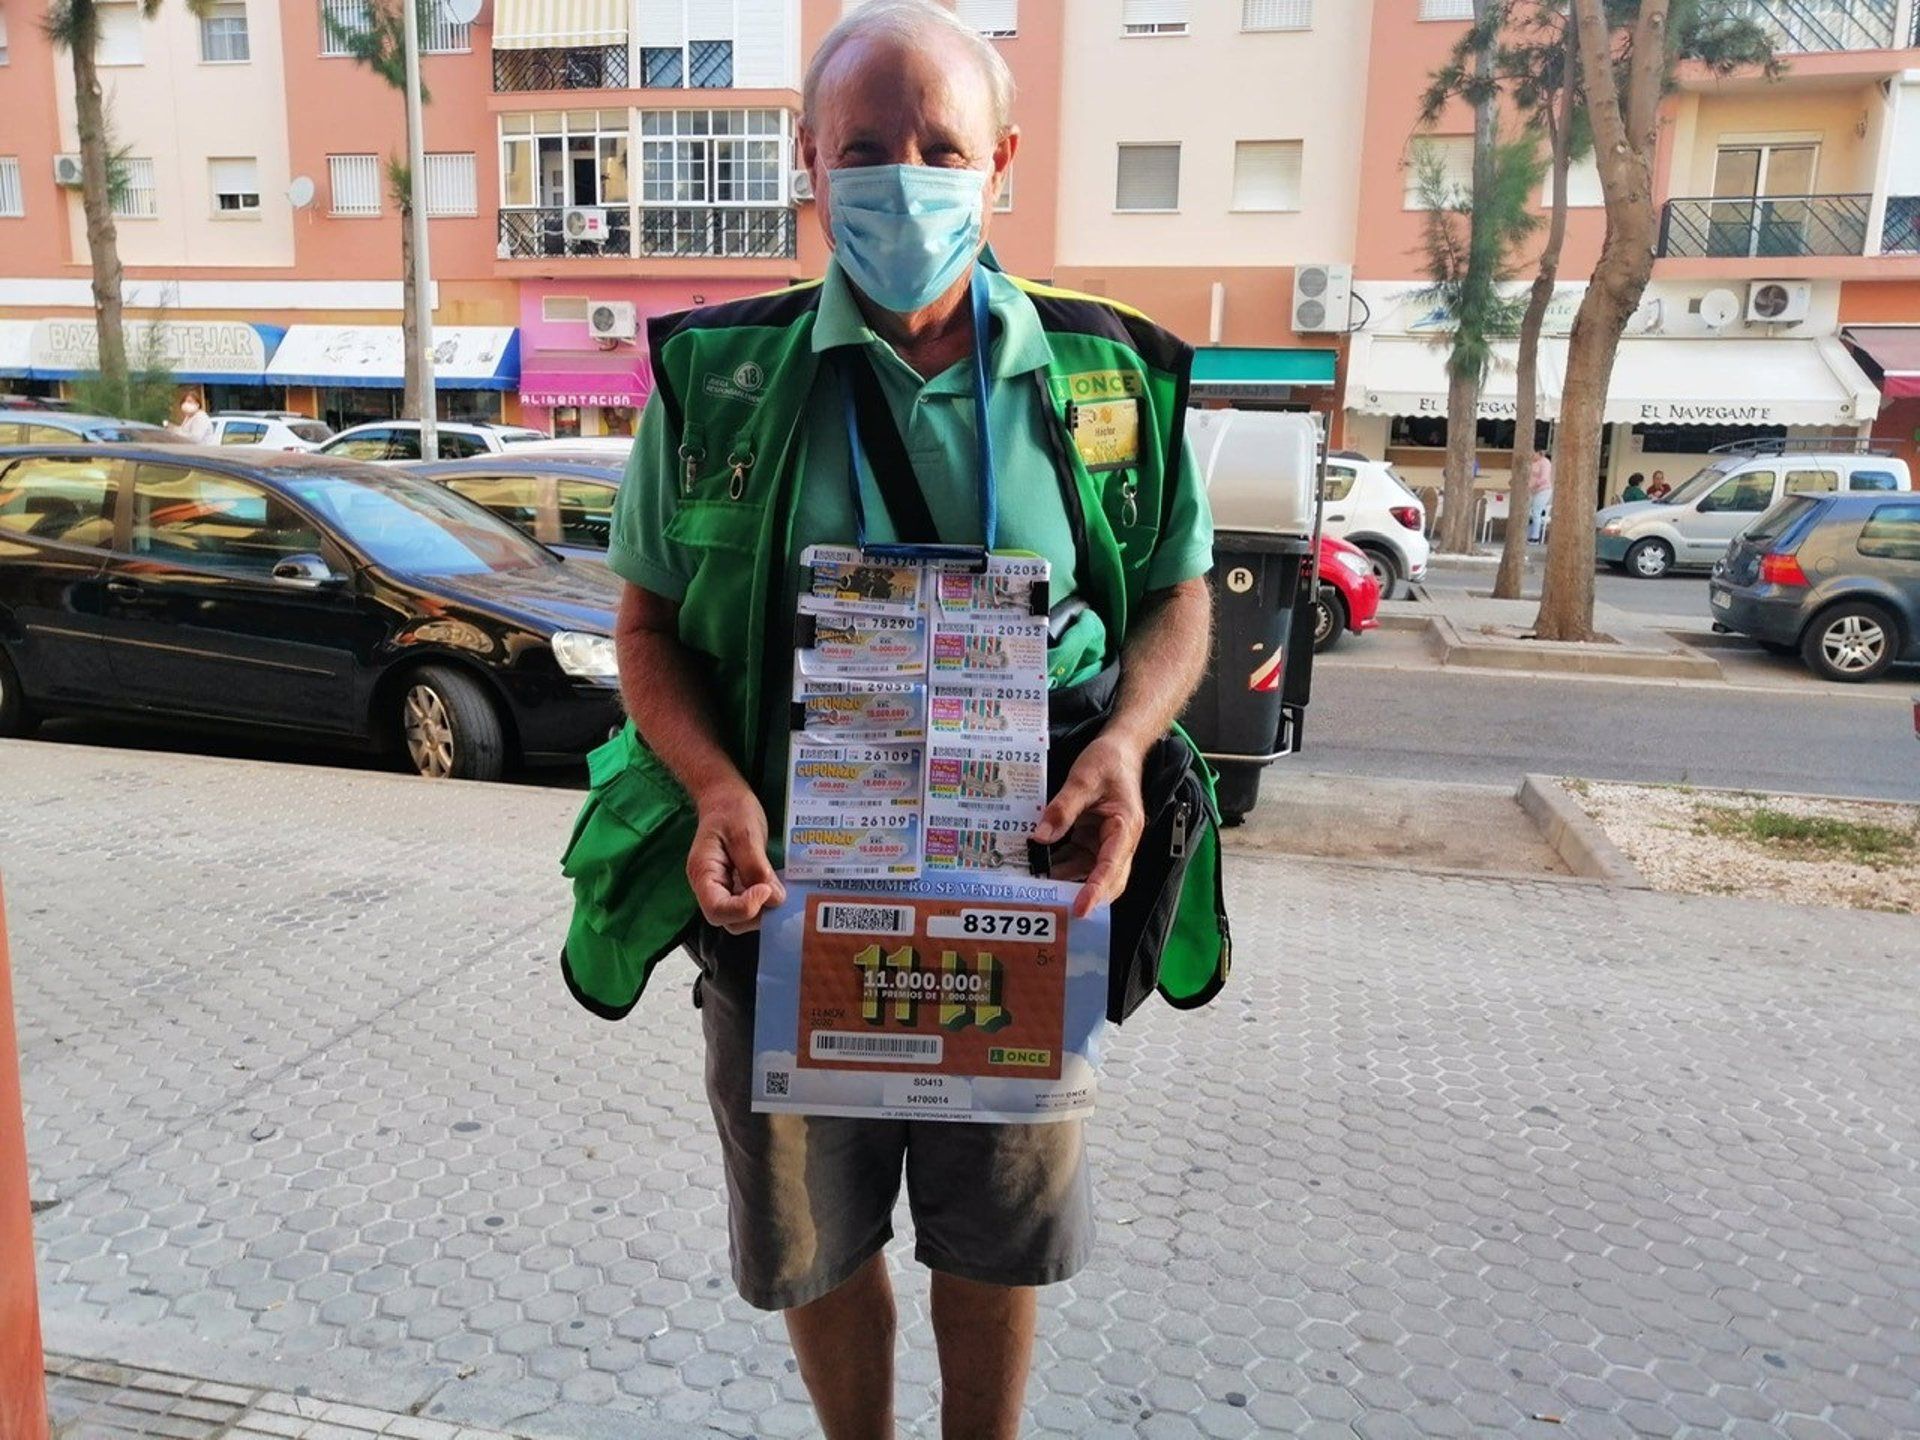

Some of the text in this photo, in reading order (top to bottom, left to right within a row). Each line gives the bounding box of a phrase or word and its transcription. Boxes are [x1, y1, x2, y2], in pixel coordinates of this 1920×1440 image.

[171, 325, 253, 356] TEJAR
[1075, 375, 1135, 395] ONCE
[521, 395, 630, 405] ALIMENTACION
[1420, 398, 1437, 411] EL
[1641, 404, 1771, 420] EL NAVEGANTE
[1004, 564, 1047, 576] 62054
[1234, 572, 1246, 584] R
[872, 618, 915, 629] 78290
[998, 625, 1041, 637] 20752
[997, 688, 1040, 699] 20752
[864, 751, 909, 761] 26109
[996, 750, 1040, 762] 20752
[861, 816, 906, 827] 26109
[993, 820, 1037, 832] 20752
[935, 882, 955, 894] SE
[958, 883, 1012, 897] VENDE
[963, 914, 1050, 936] 83792
[881, 990, 923, 999] PREMIOS
[925, 991, 937, 1000] DE
[1006, 1051, 1048, 1063] ONCE
[1066, 1089, 1088, 1098] ONCE
